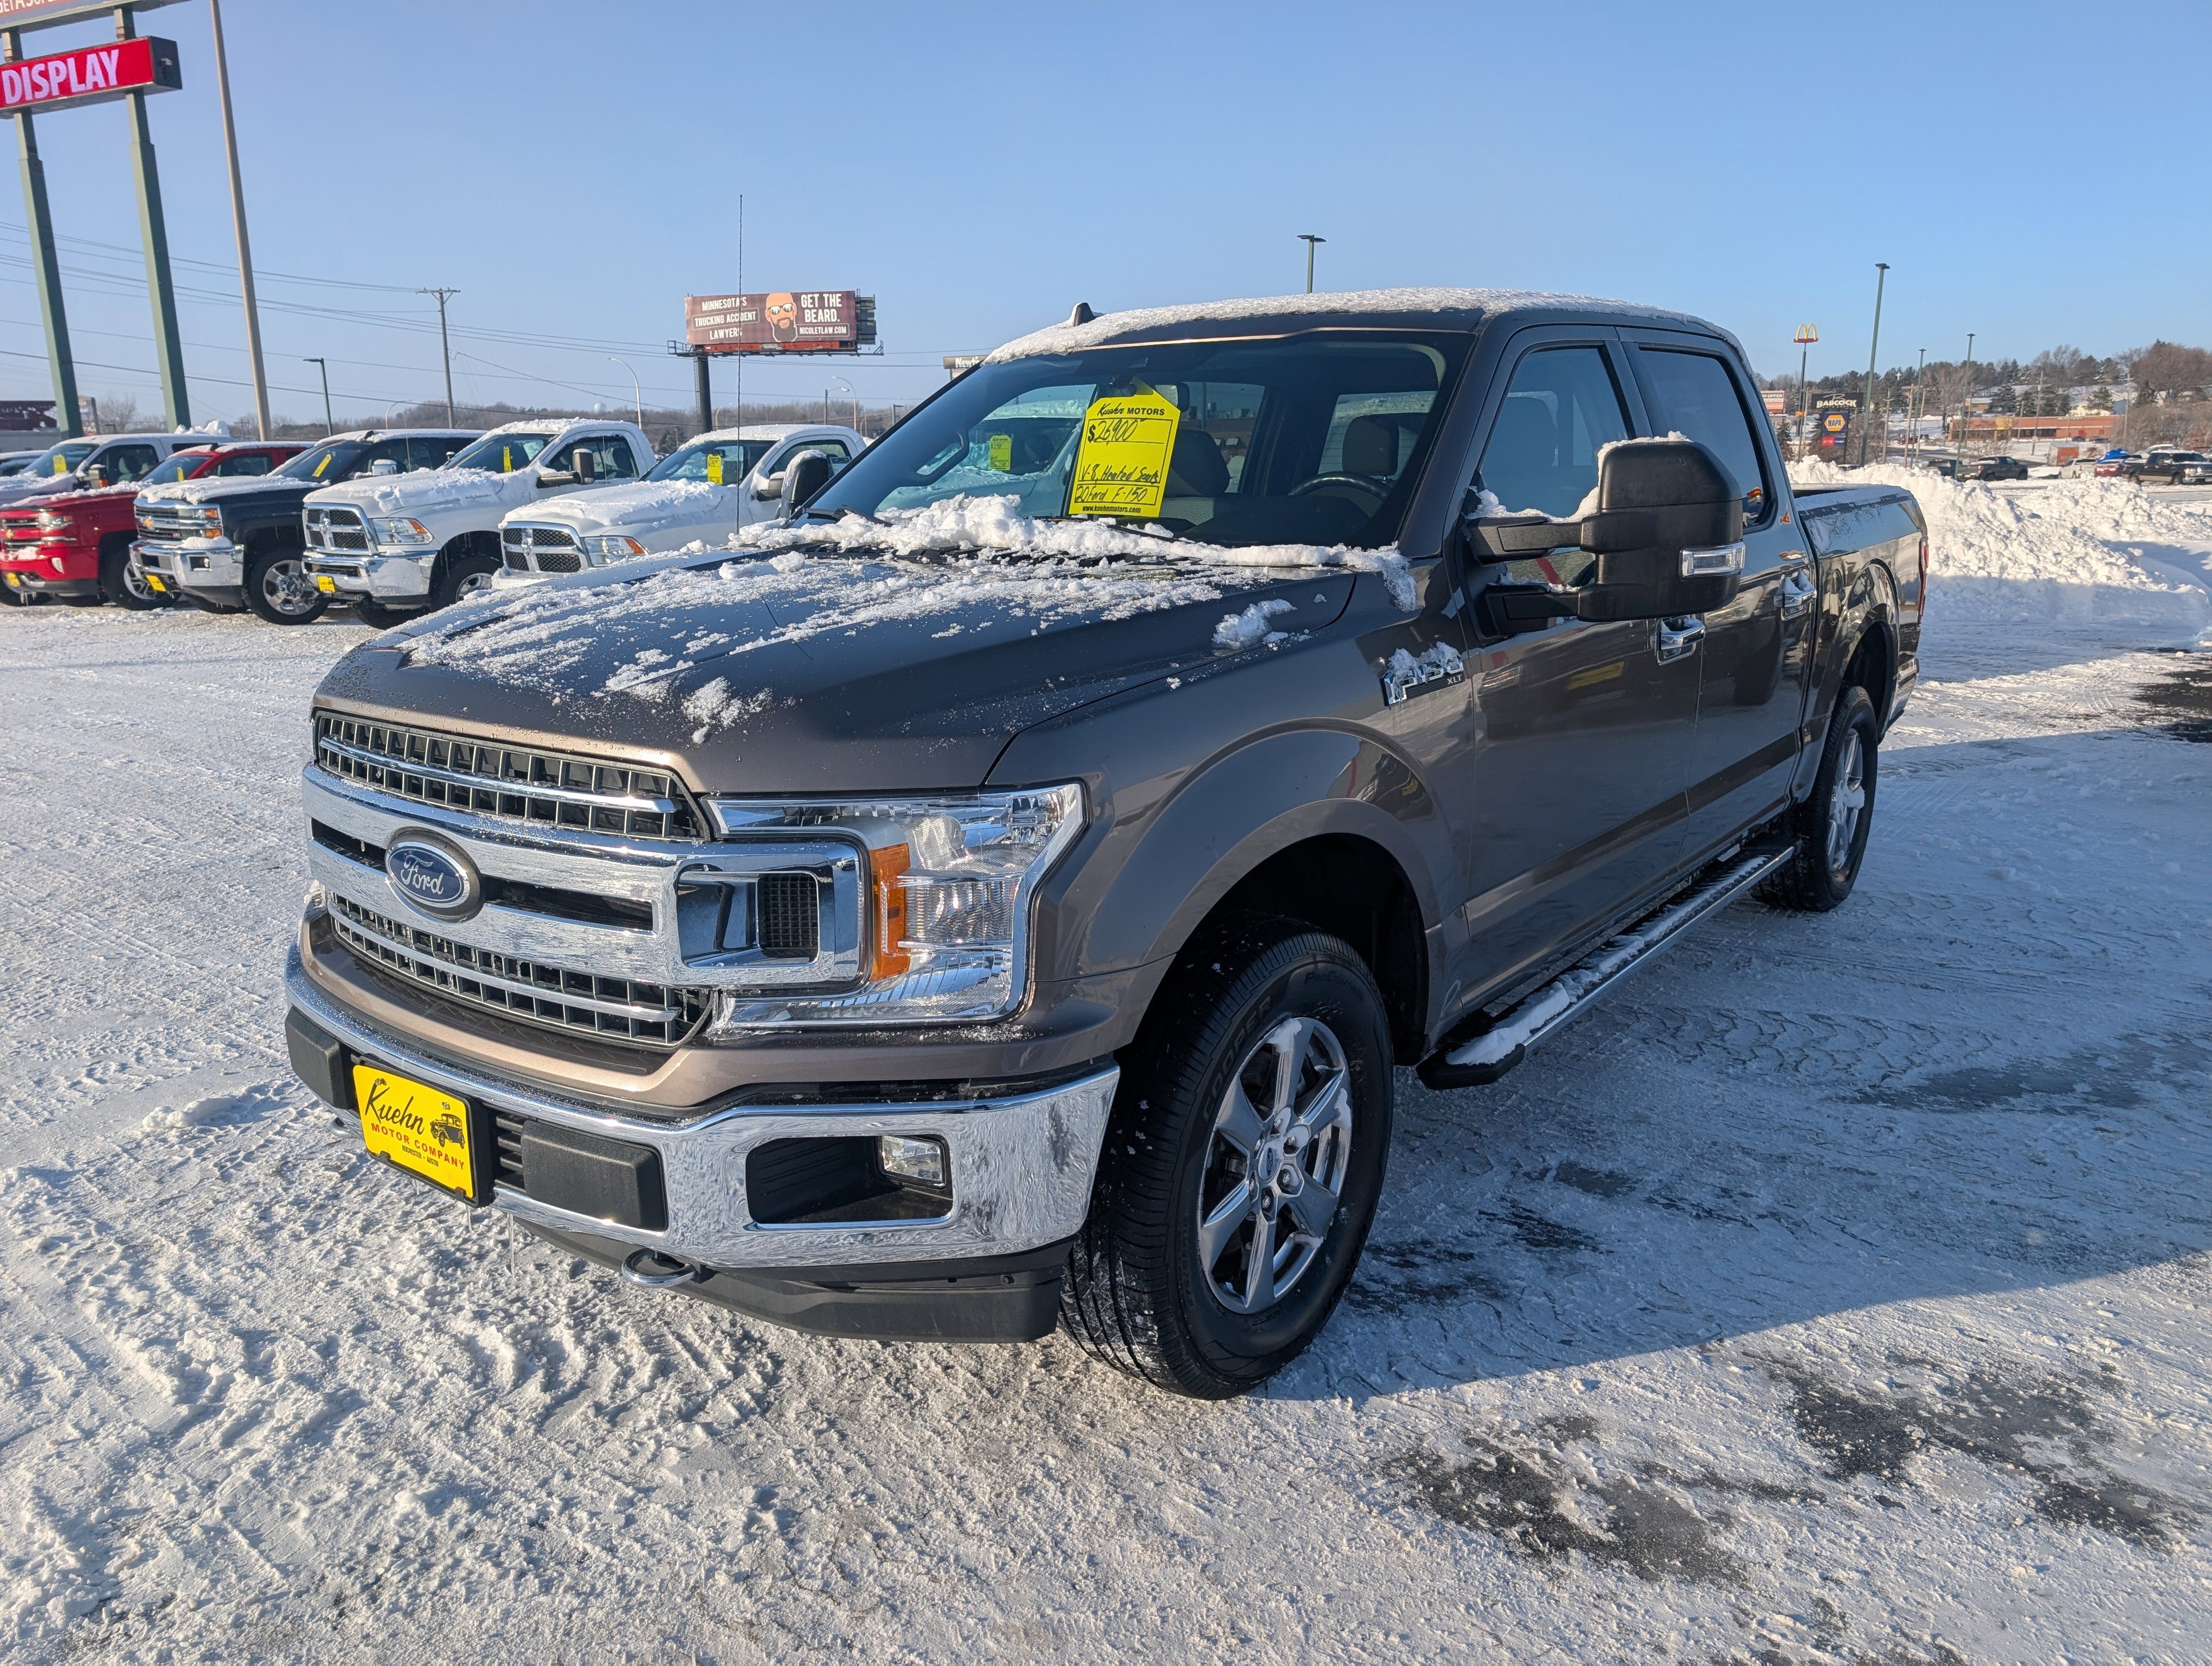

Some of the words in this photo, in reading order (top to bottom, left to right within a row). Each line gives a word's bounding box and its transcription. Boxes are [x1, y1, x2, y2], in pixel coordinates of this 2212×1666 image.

[1, 48, 120, 105] DISPLAY
[701, 296, 748, 312] MINNESOTA'S
[800, 293, 819, 308] GET
[822, 293, 843, 307] THE
[694, 312, 725, 328] TRUCKING
[725, 310, 757, 324] ACCIDENT
[803, 308, 841, 323] BEARD.
[709, 327, 743, 341] LAWYERS
[799, 325, 847, 335] NICOLETLAW.COM
[1097, 402, 1125, 417] Kuehn
[1127, 407, 1165, 416] MOTORS
[1816, 399, 1857, 408] BABCOCK
[1100, 464, 1139, 481] Heated
[1111, 486, 1148, 502] F-150
[1082, 505, 1141, 514] www.kuehnmotors.com
[1446, 674, 1462, 685] XLT
[400, 854, 444, 895] Ford
[364, 1082, 425, 1135] Kuehn
[371, 1122, 410, 1145] MOTOR
[414, 1139, 465, 1170] COMPANY
